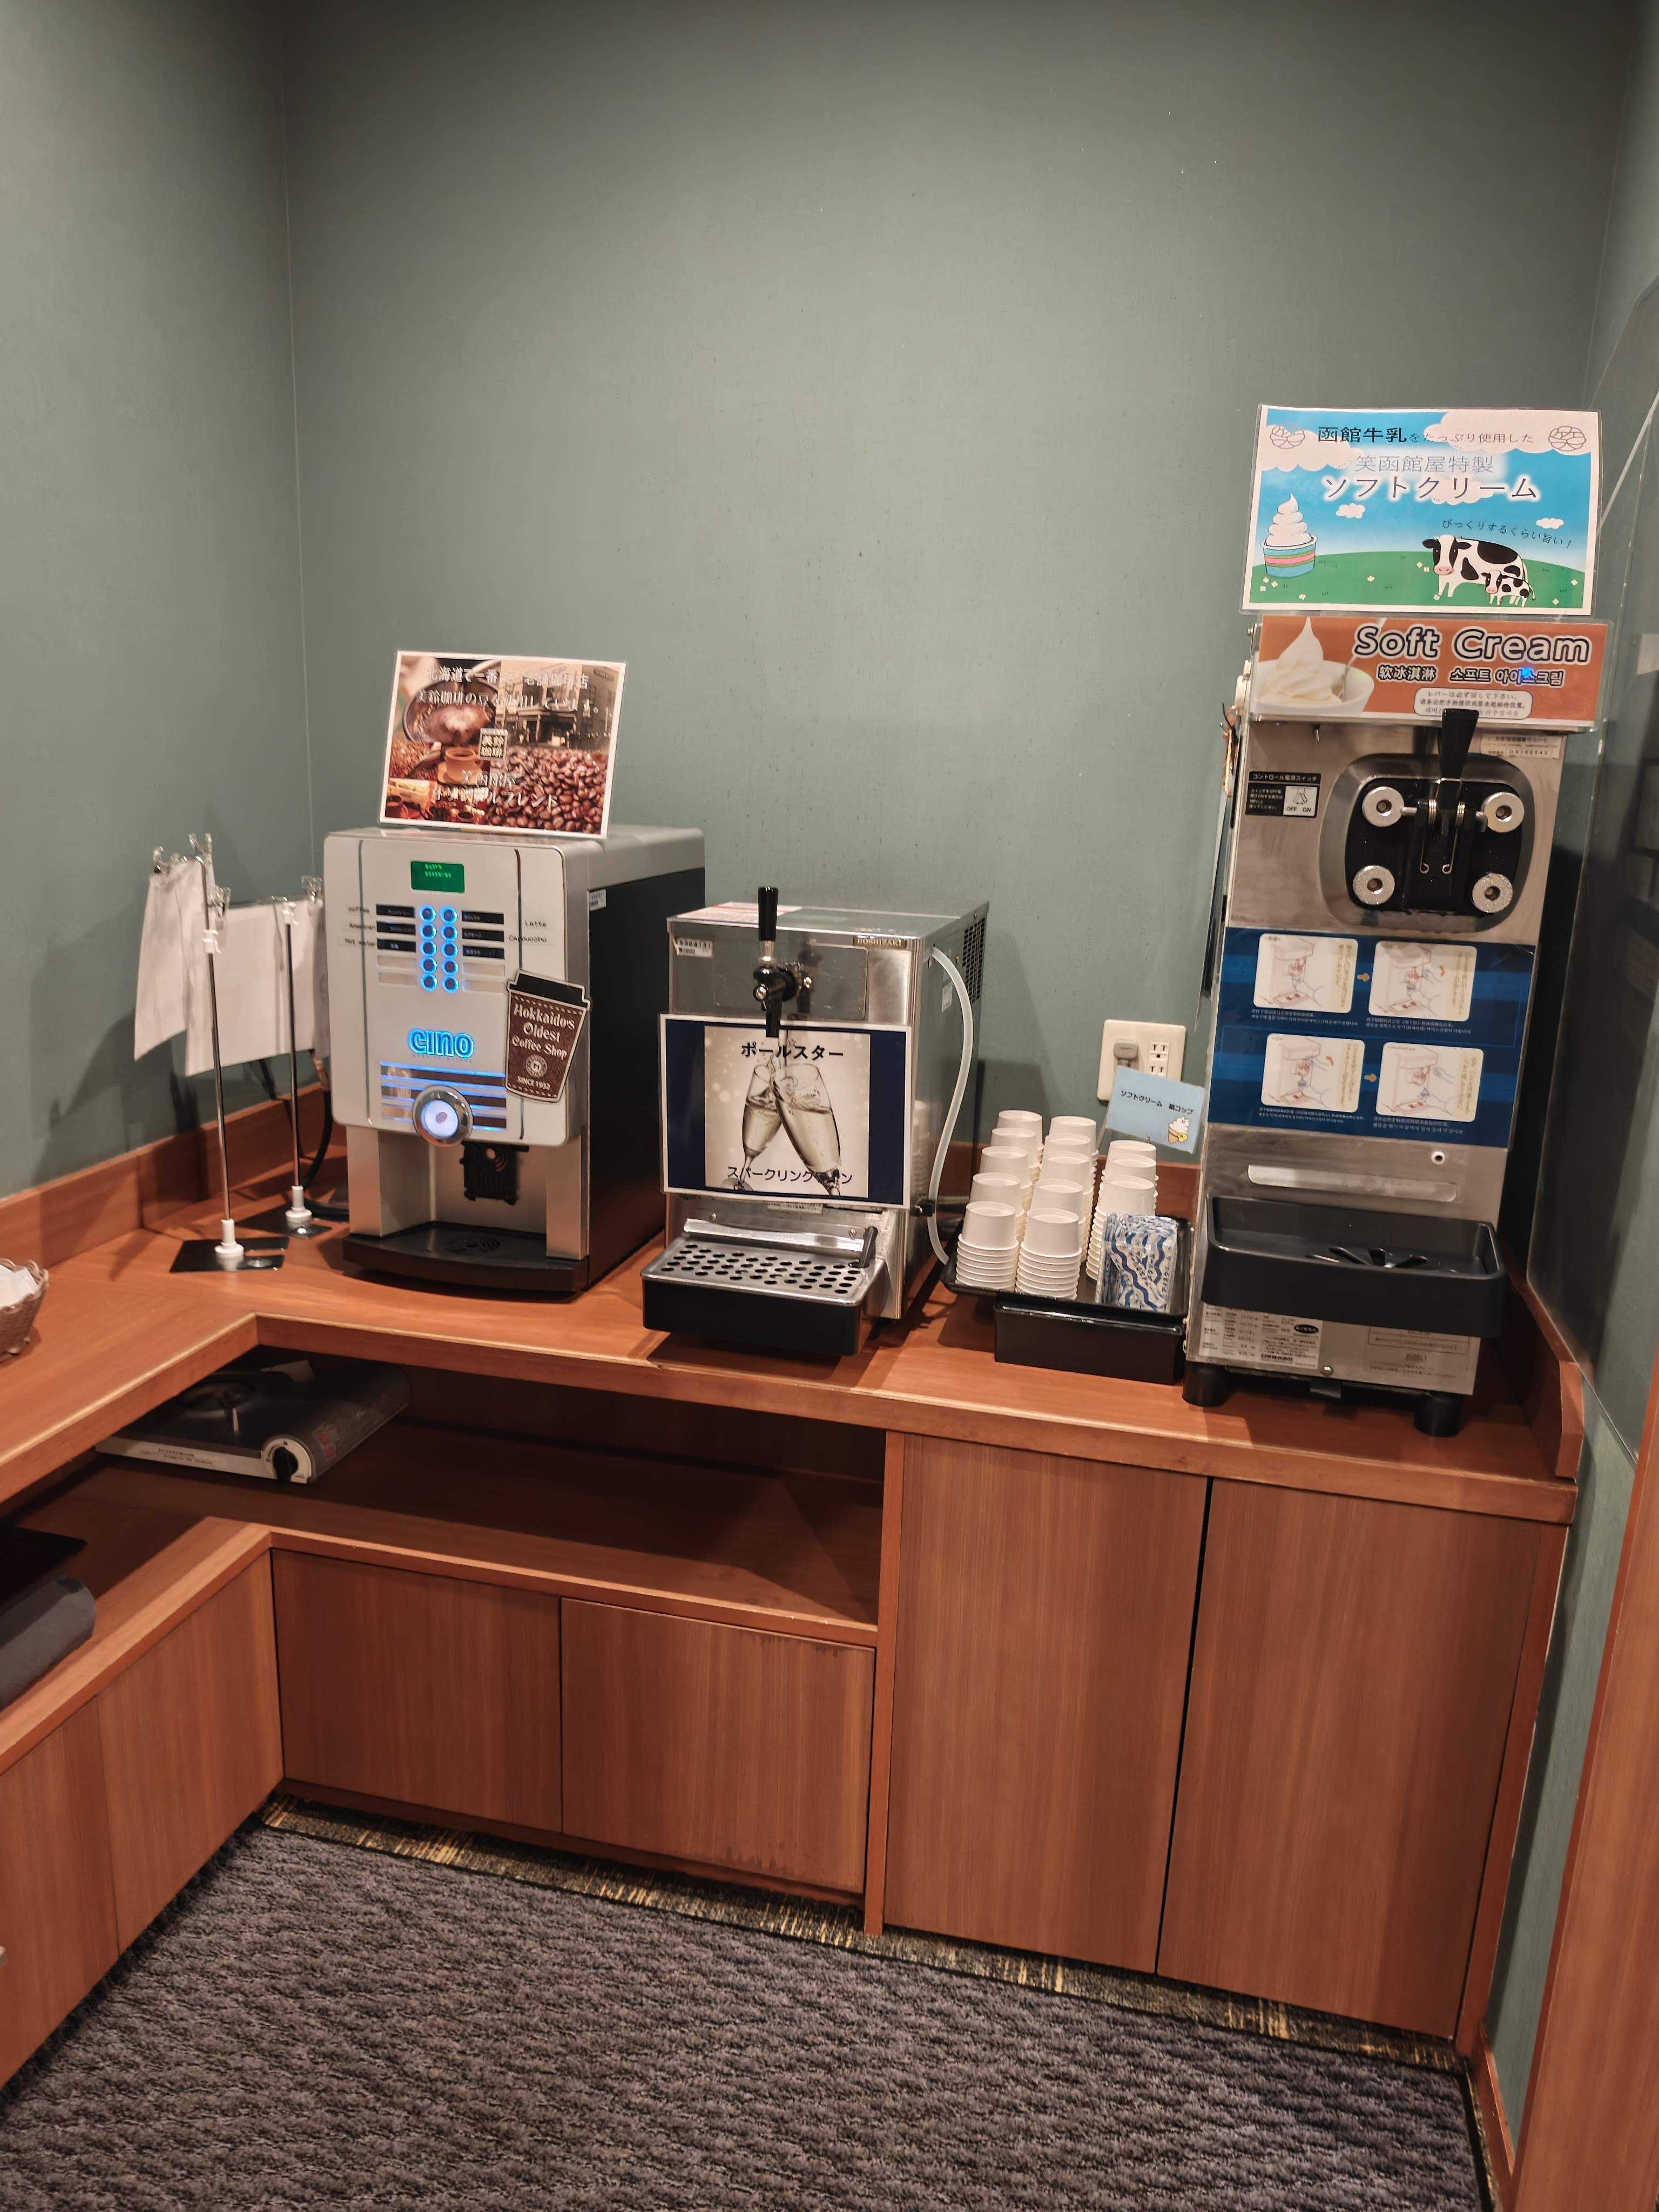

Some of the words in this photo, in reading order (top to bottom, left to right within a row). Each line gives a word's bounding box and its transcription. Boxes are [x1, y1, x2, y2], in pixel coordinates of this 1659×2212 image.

[1355, 455, 1494, 473] 笑函館屋特製
[1325, 476, 1536, 498] ソフトクリーム
[1353, 624, 1441, 659] Soft
[1453, 627, 1590, 663] Cream
[1449, 667, 1492, 682] 소프트
[1494, 668, 1564, 686] 아이스크림
[513, 1003, 575, 1030] Hokkaido's
[523, 1021, 561, 1043] Oldest
[511, 1035, 542, 1053] Coffee
[543, 1043, 568, 1061] Shop
[741, 1041, 844, 1061] ポールスター
[1121, 1089, 1163, 1107] ソフトクリーム
[1168, 1103, 1195, 1115] 紙コップ
